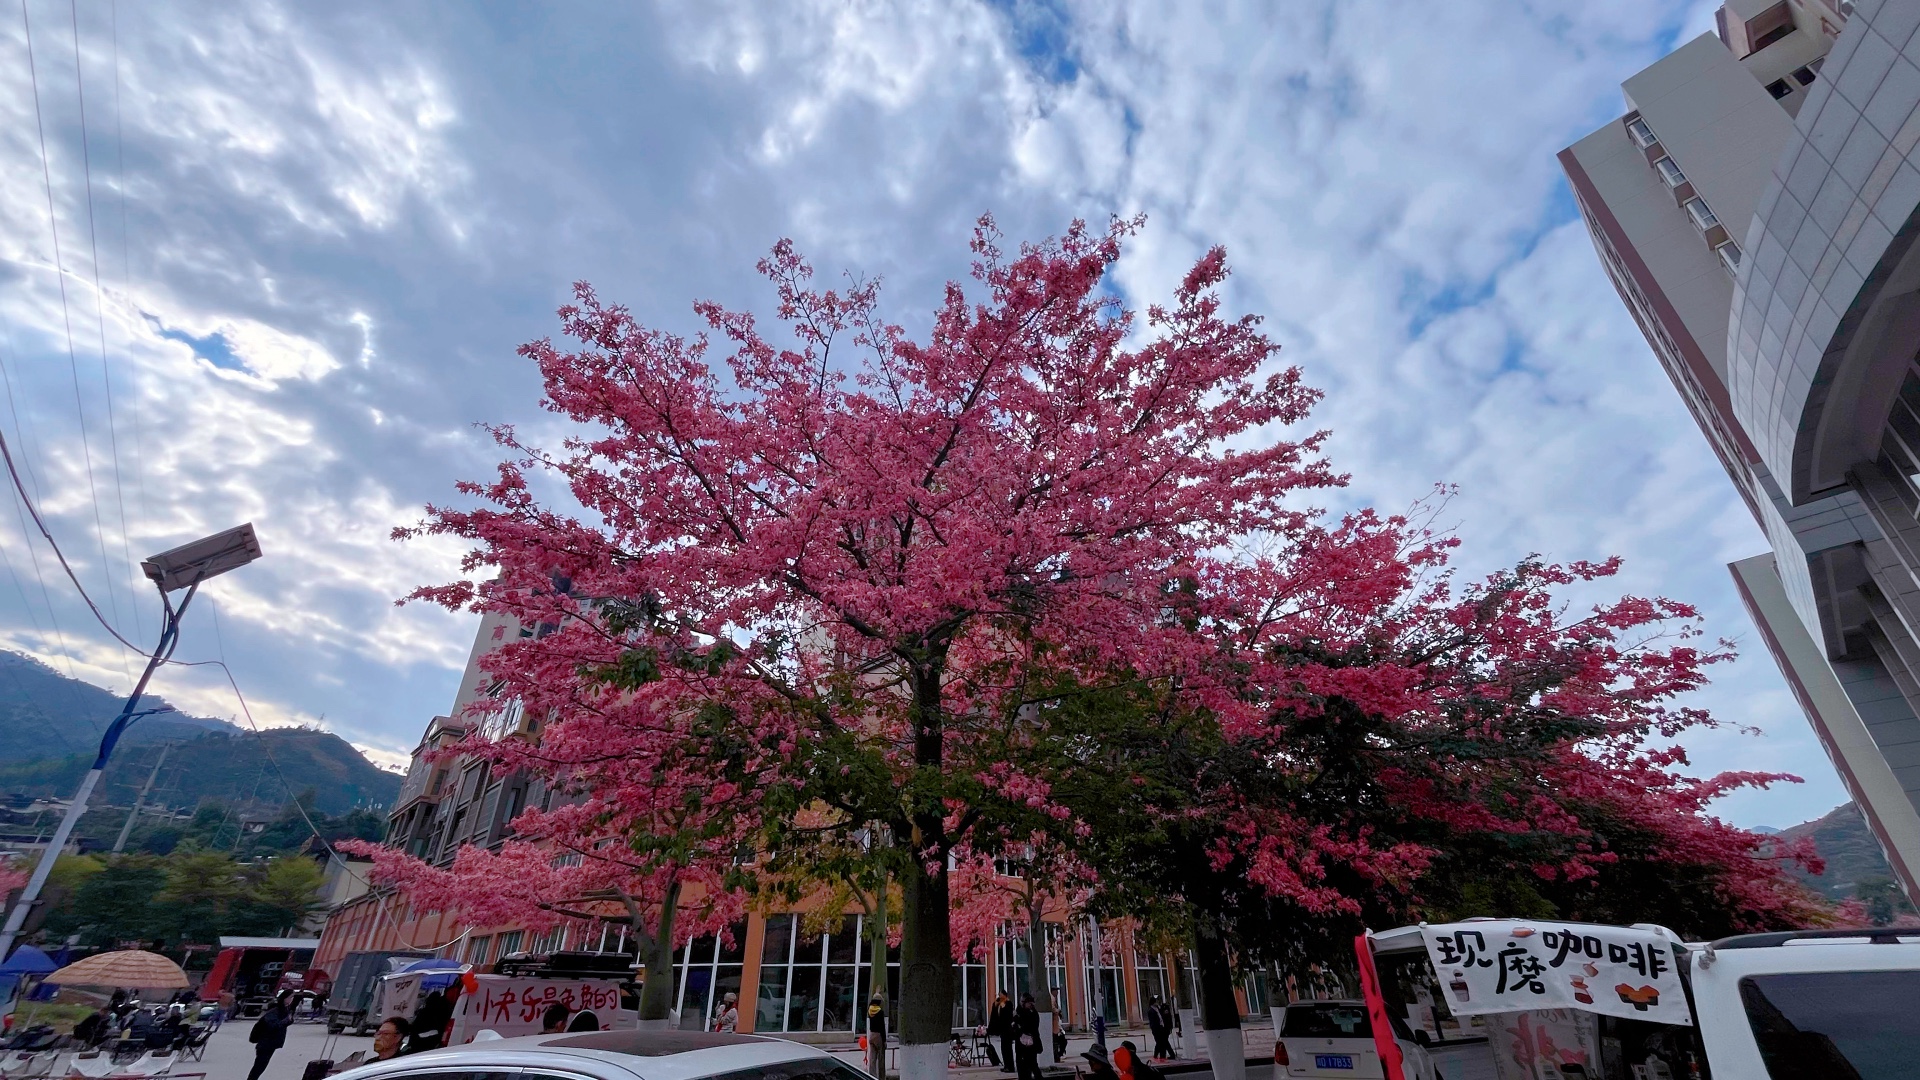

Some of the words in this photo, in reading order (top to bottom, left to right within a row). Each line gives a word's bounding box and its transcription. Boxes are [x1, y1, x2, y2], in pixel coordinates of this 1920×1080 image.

[1436, 929, 1668, 994] 现磨咖啡
[476, 983, 618, 1024] 快乐是免费的
